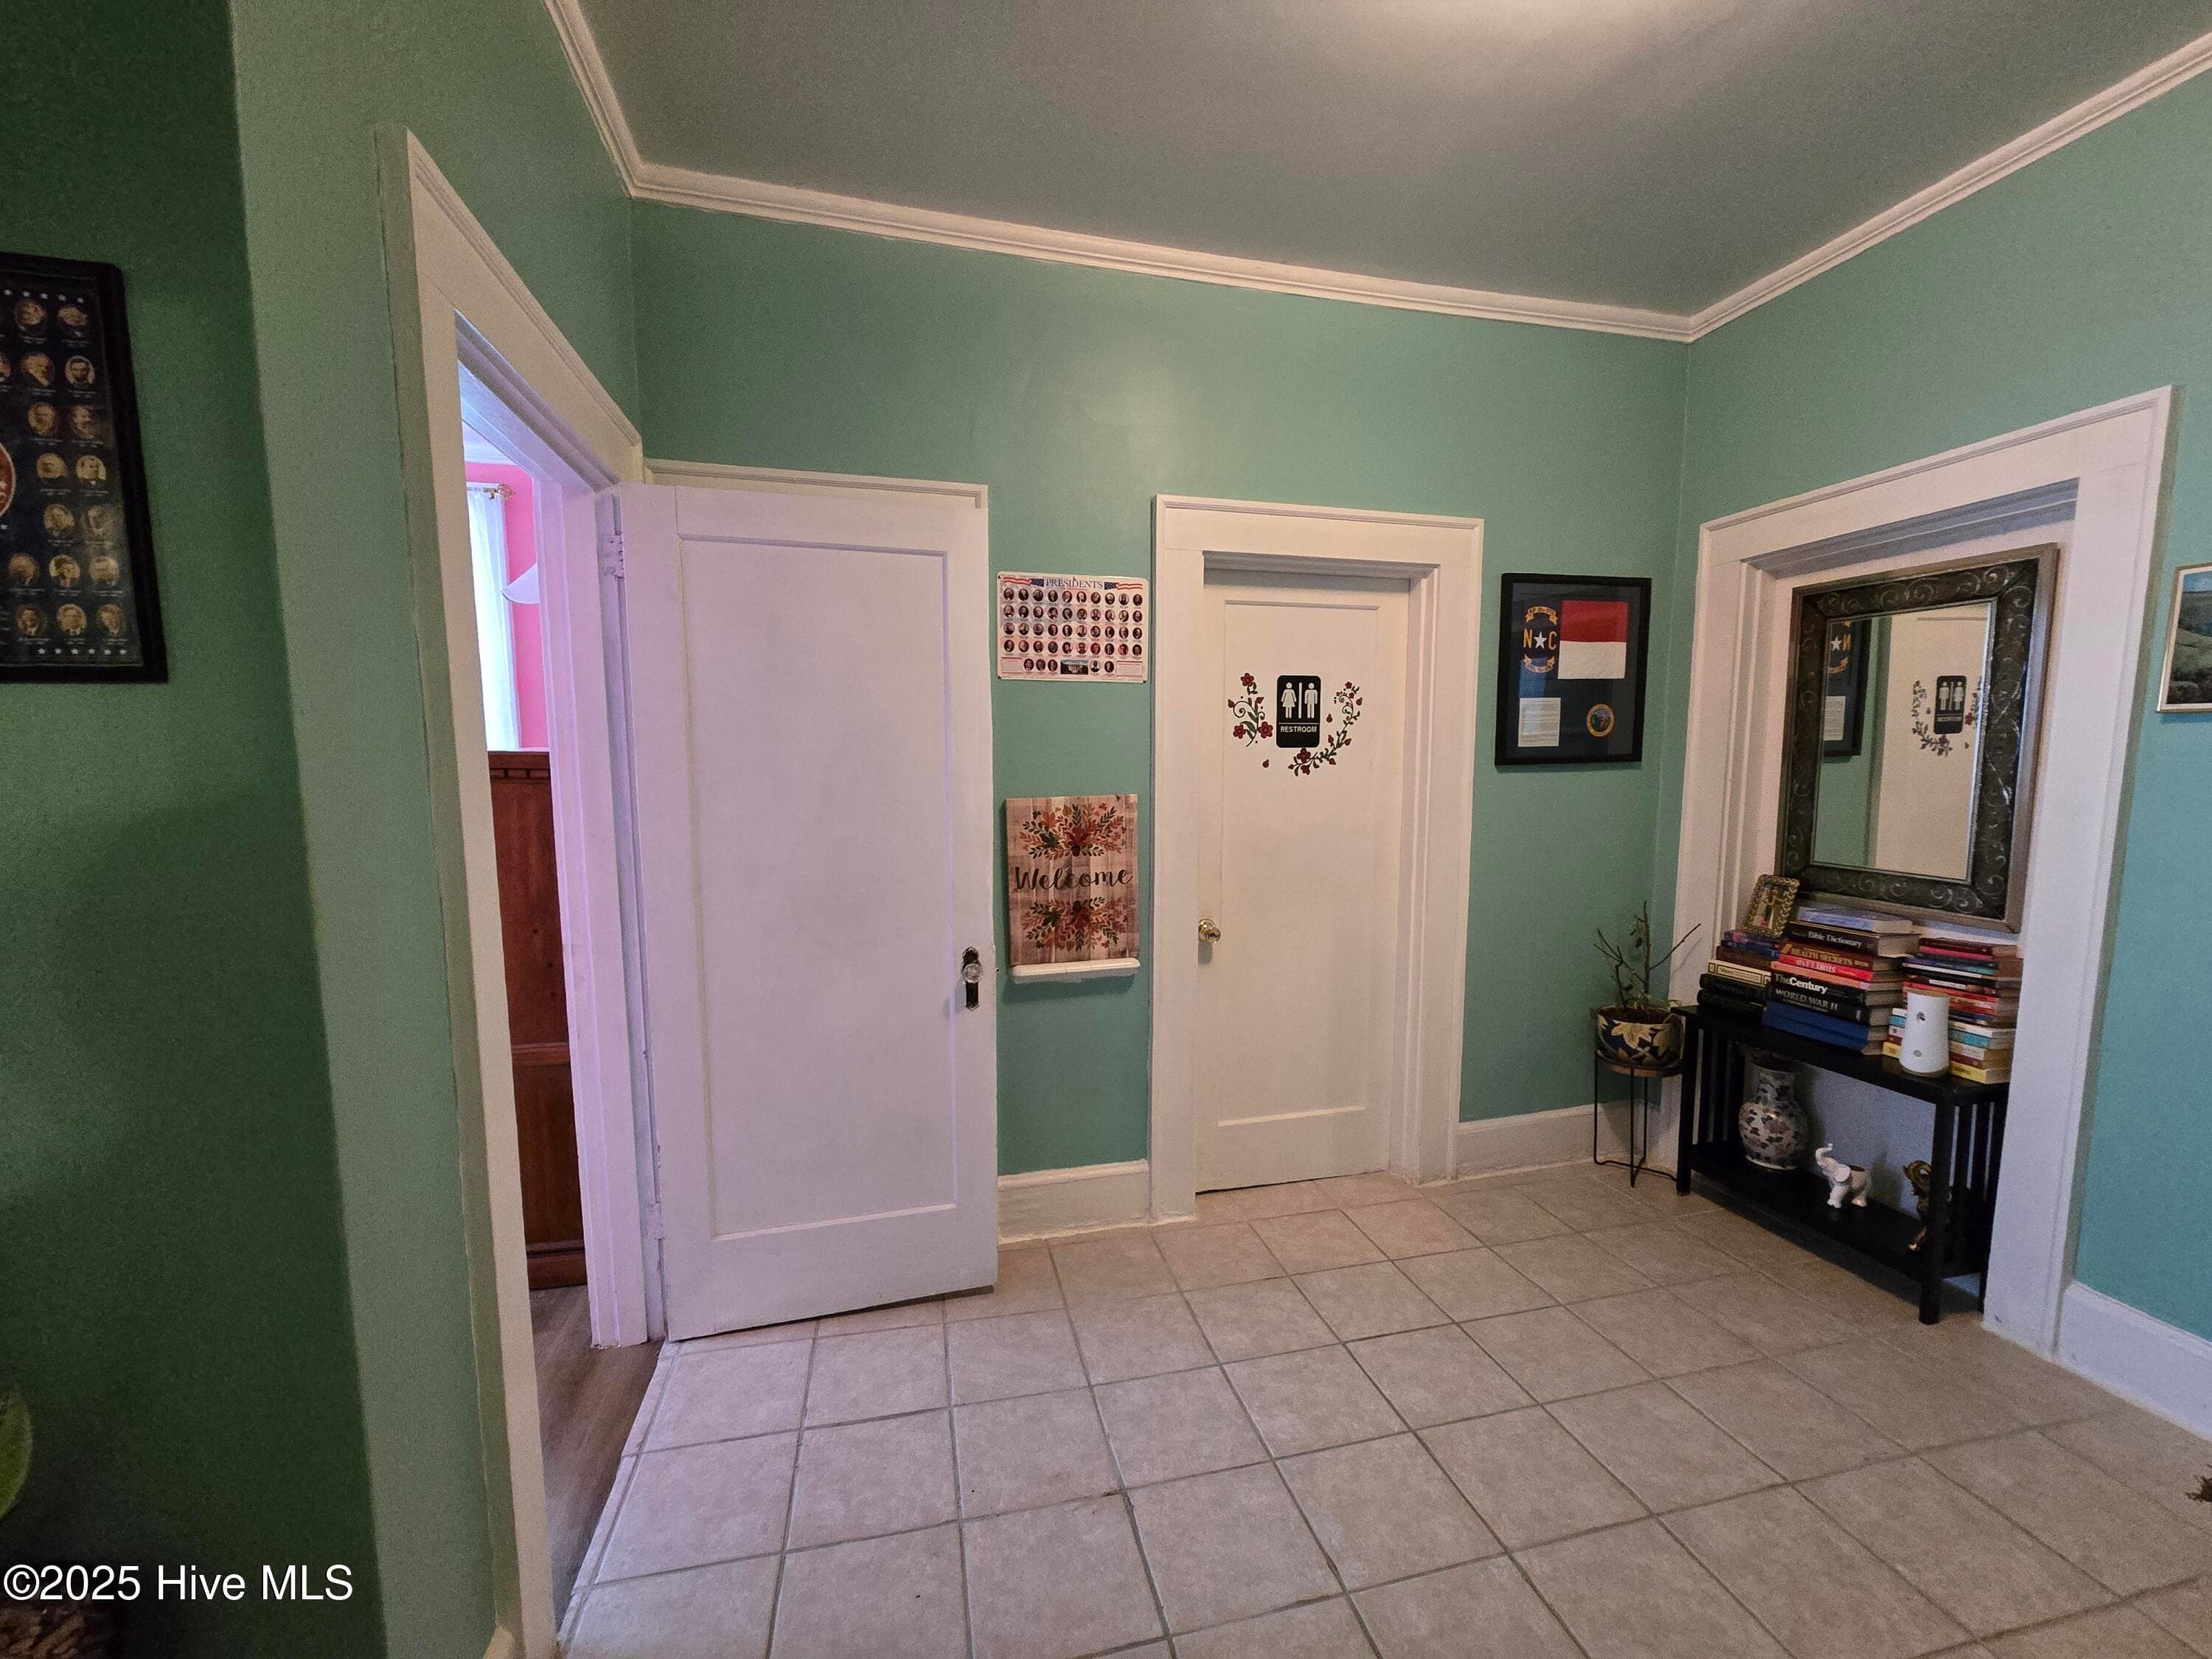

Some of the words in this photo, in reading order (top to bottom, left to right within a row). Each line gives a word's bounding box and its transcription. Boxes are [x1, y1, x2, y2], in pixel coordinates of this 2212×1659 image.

[1046, 578, 1103, 589] PRESIDENTS
[1523, 628, 1533, 648] N
[1548, 630, 1557, 650] C
[1015, 866, 1134, 891] Welcome
[1808, 931, 1825, 941] Bible
[1826, 934, 1862, 948] Dictionary
[1791, 947, 1819, 959] HEALTH
[1775, 989, 1806, 1003] WORLD
[1809, 996, 1829, 1008] WAR
